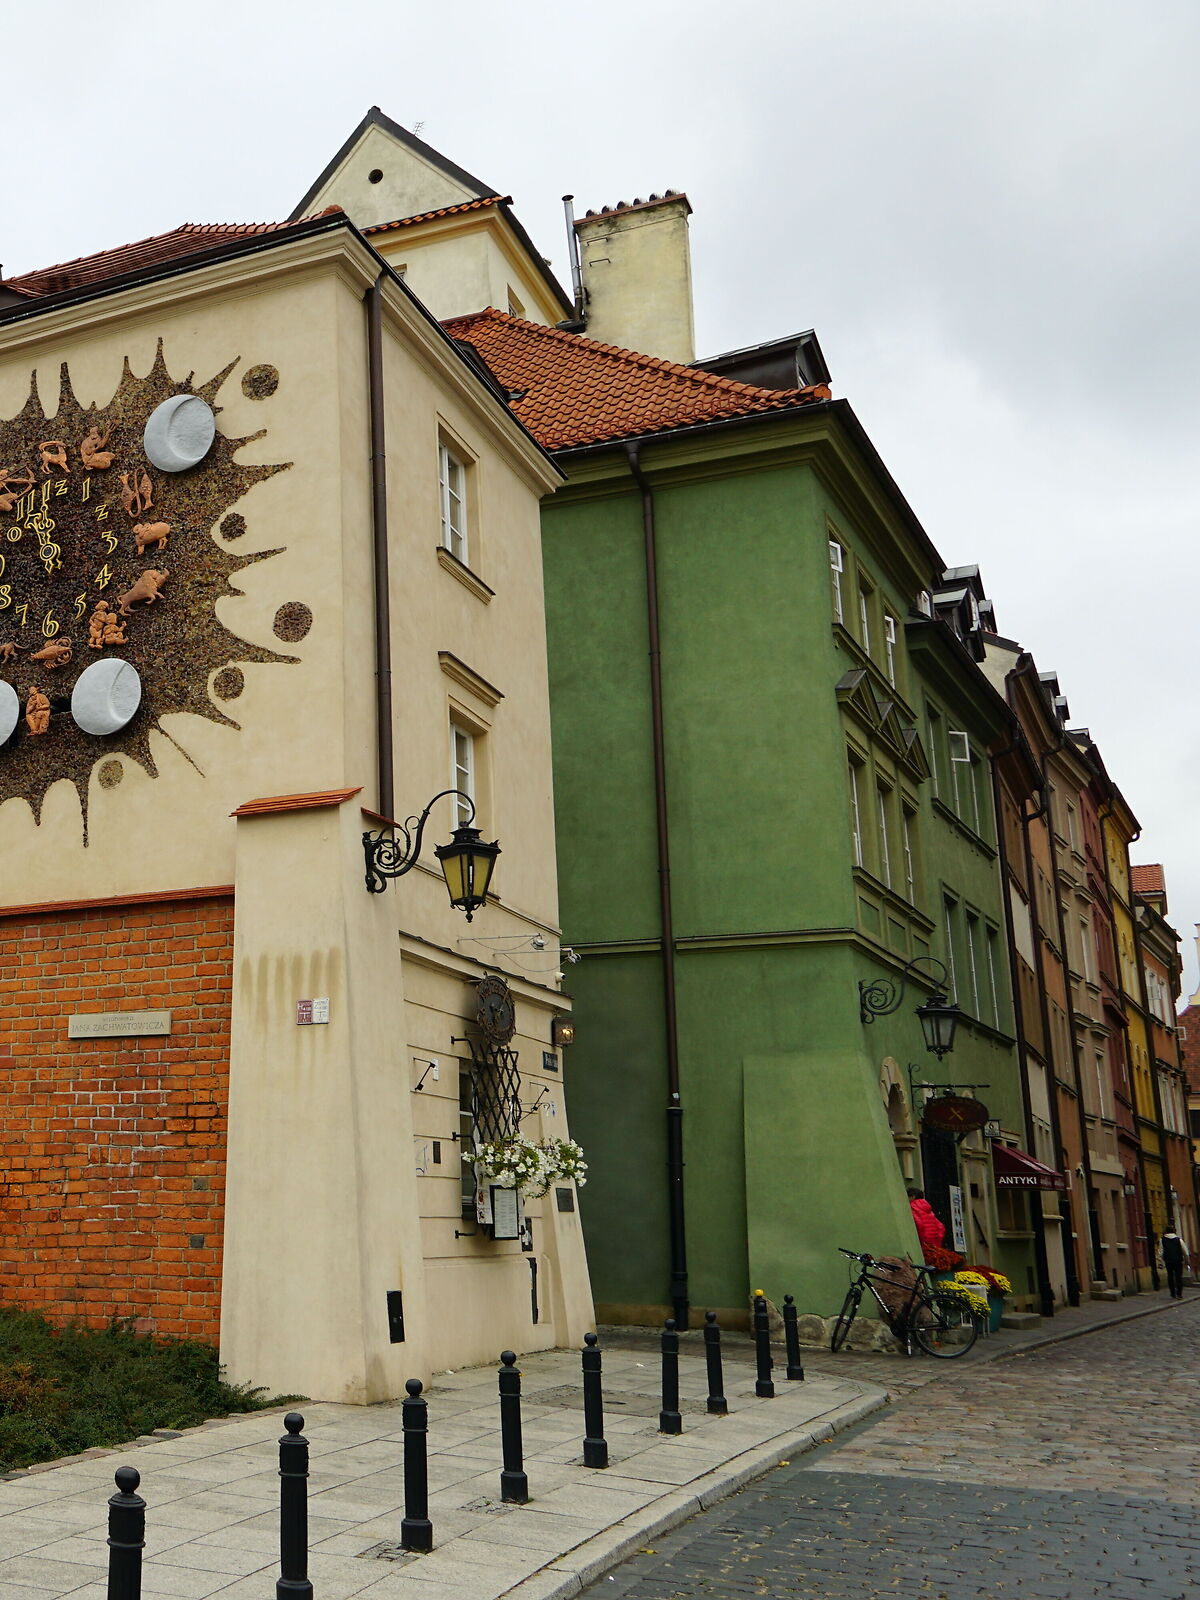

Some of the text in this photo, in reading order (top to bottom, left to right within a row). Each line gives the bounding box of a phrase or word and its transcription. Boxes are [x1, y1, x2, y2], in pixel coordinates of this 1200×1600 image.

[82, 477, 90, 502] 1
[16, 489, 35, 522] 11
[101, 530, 118, 554] 3
[95, 563, 113, 590] 4
[15, 603, 29, 626] 7
[74, 592, 87, 620] 5
[42, 609, 60, 637] 6
[998, 1176, 1037, 1184] ANTYKI
